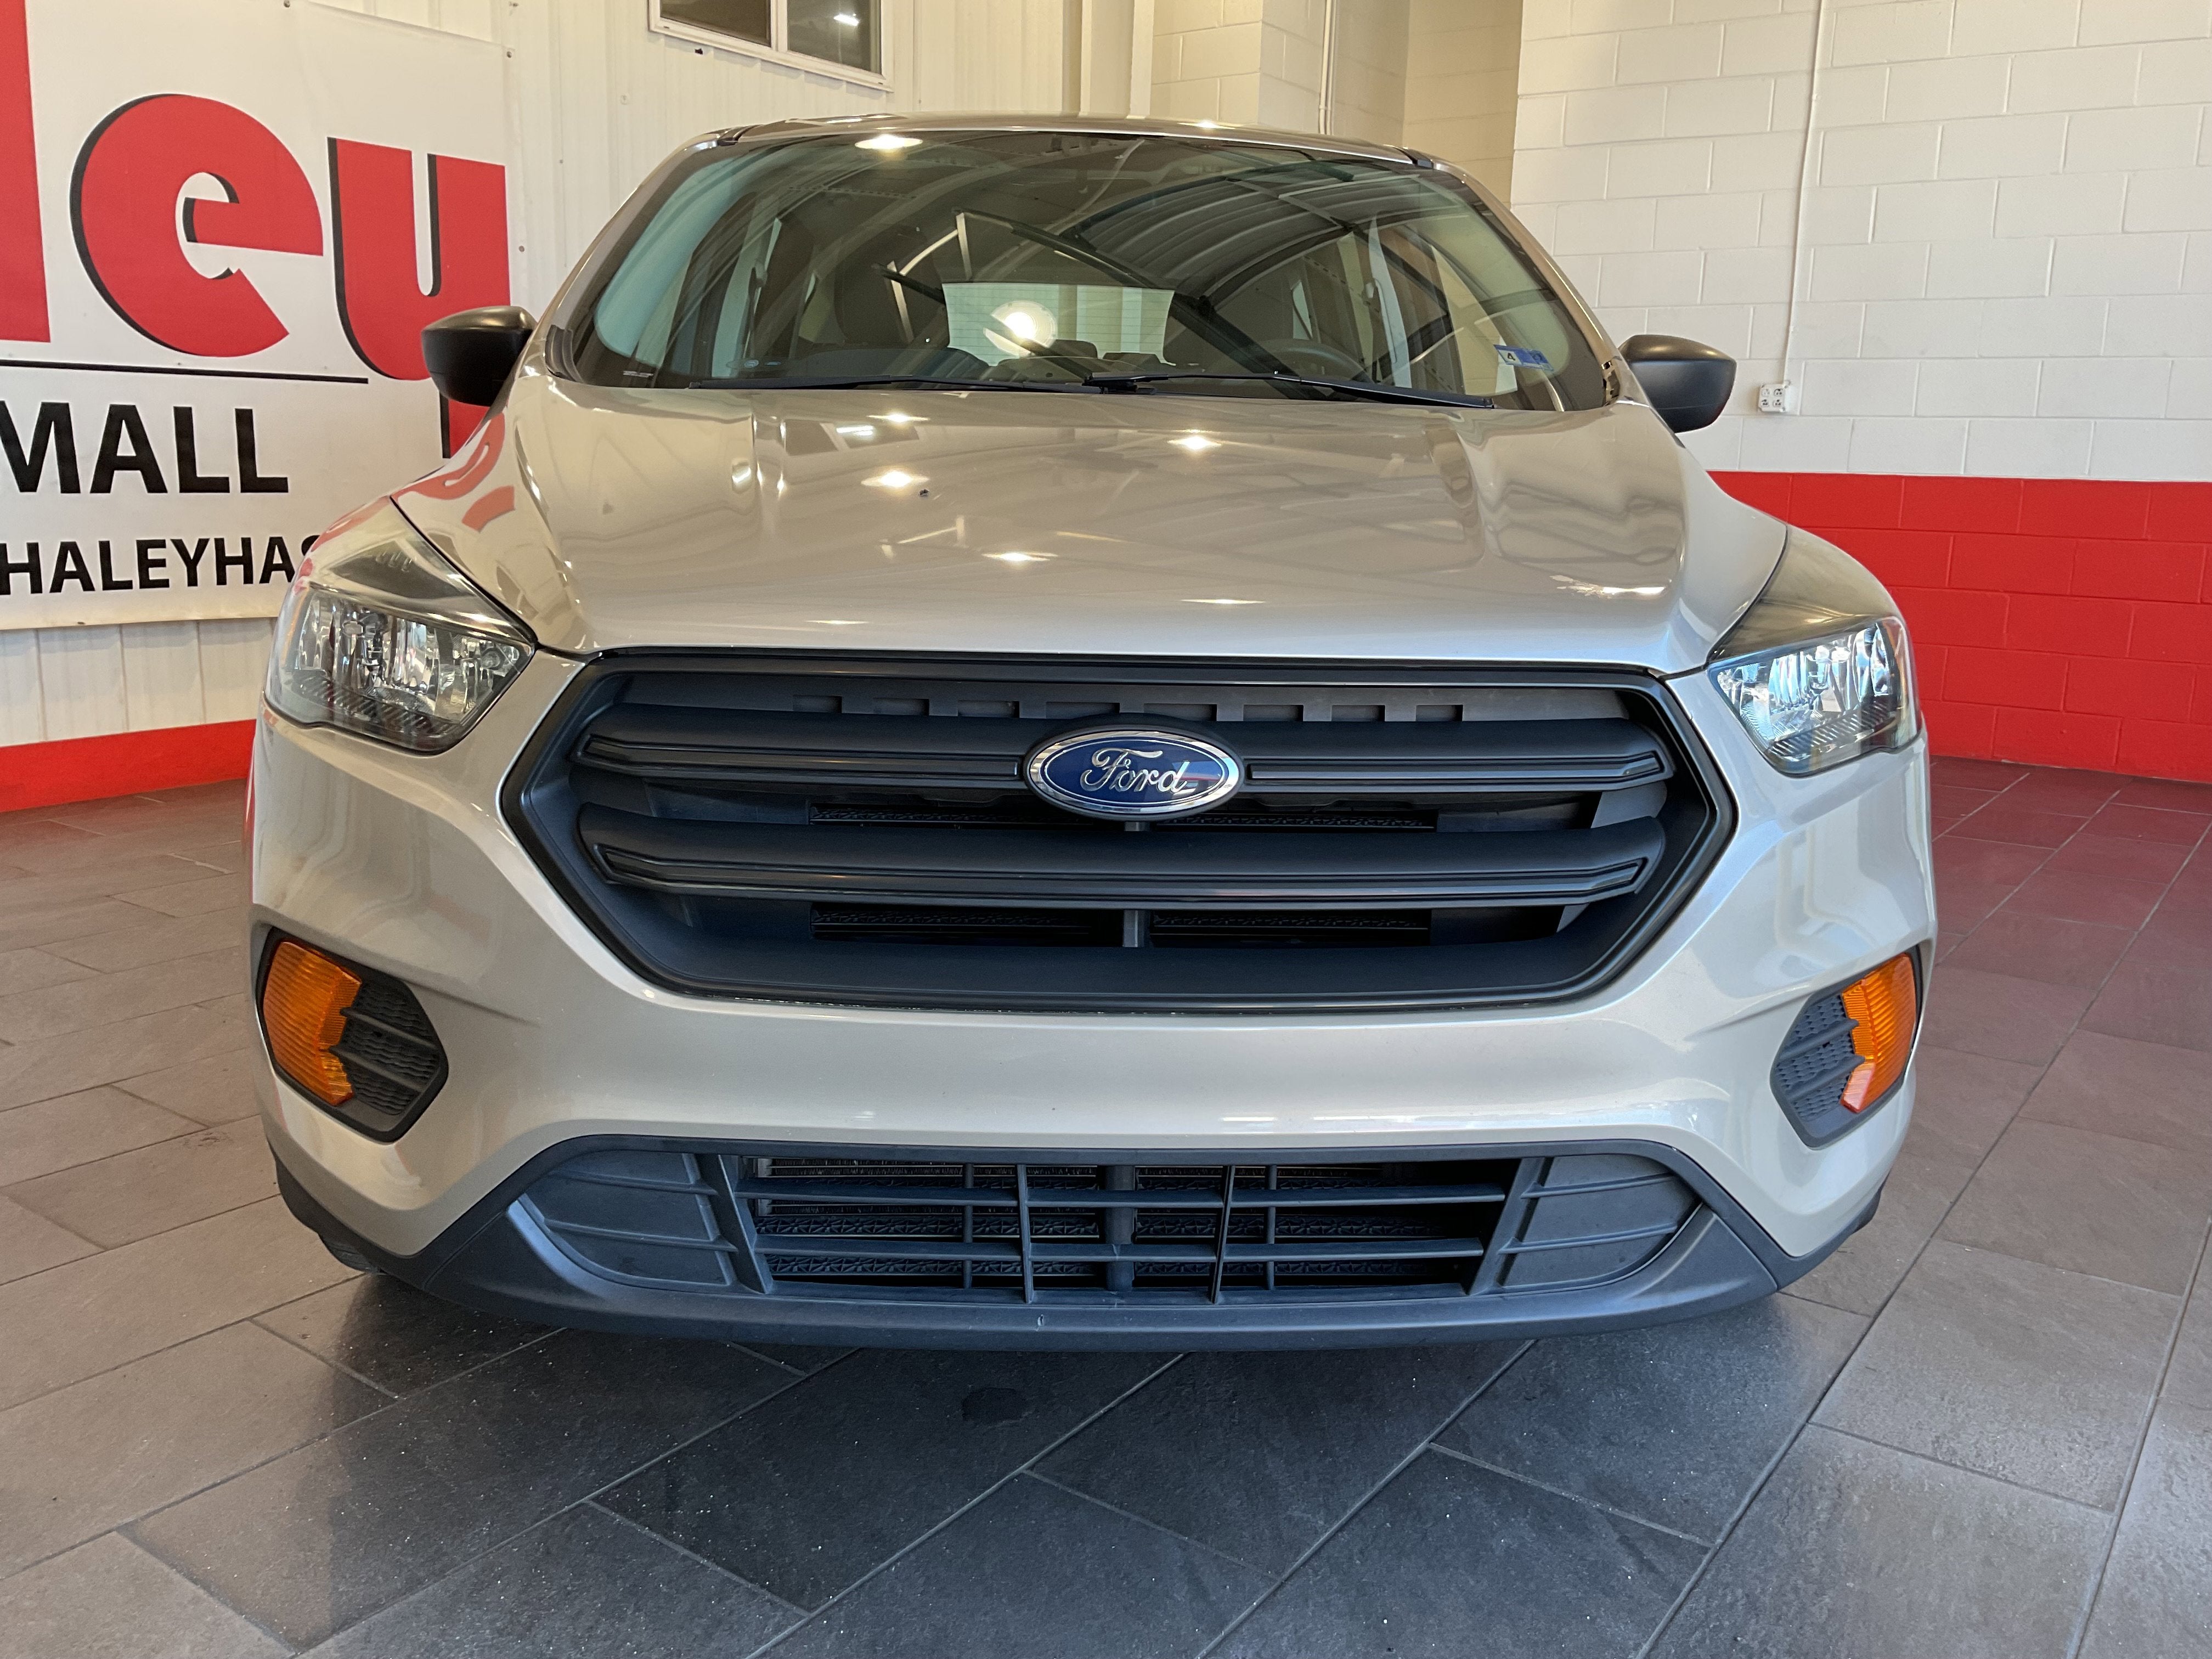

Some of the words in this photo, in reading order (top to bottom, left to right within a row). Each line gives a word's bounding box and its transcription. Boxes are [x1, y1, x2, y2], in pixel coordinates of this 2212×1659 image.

[0, 400, 289, 494] MALL
[0, 535, 320, 595] HALEYHA
[1080, 747, 1197, 794] Ford
